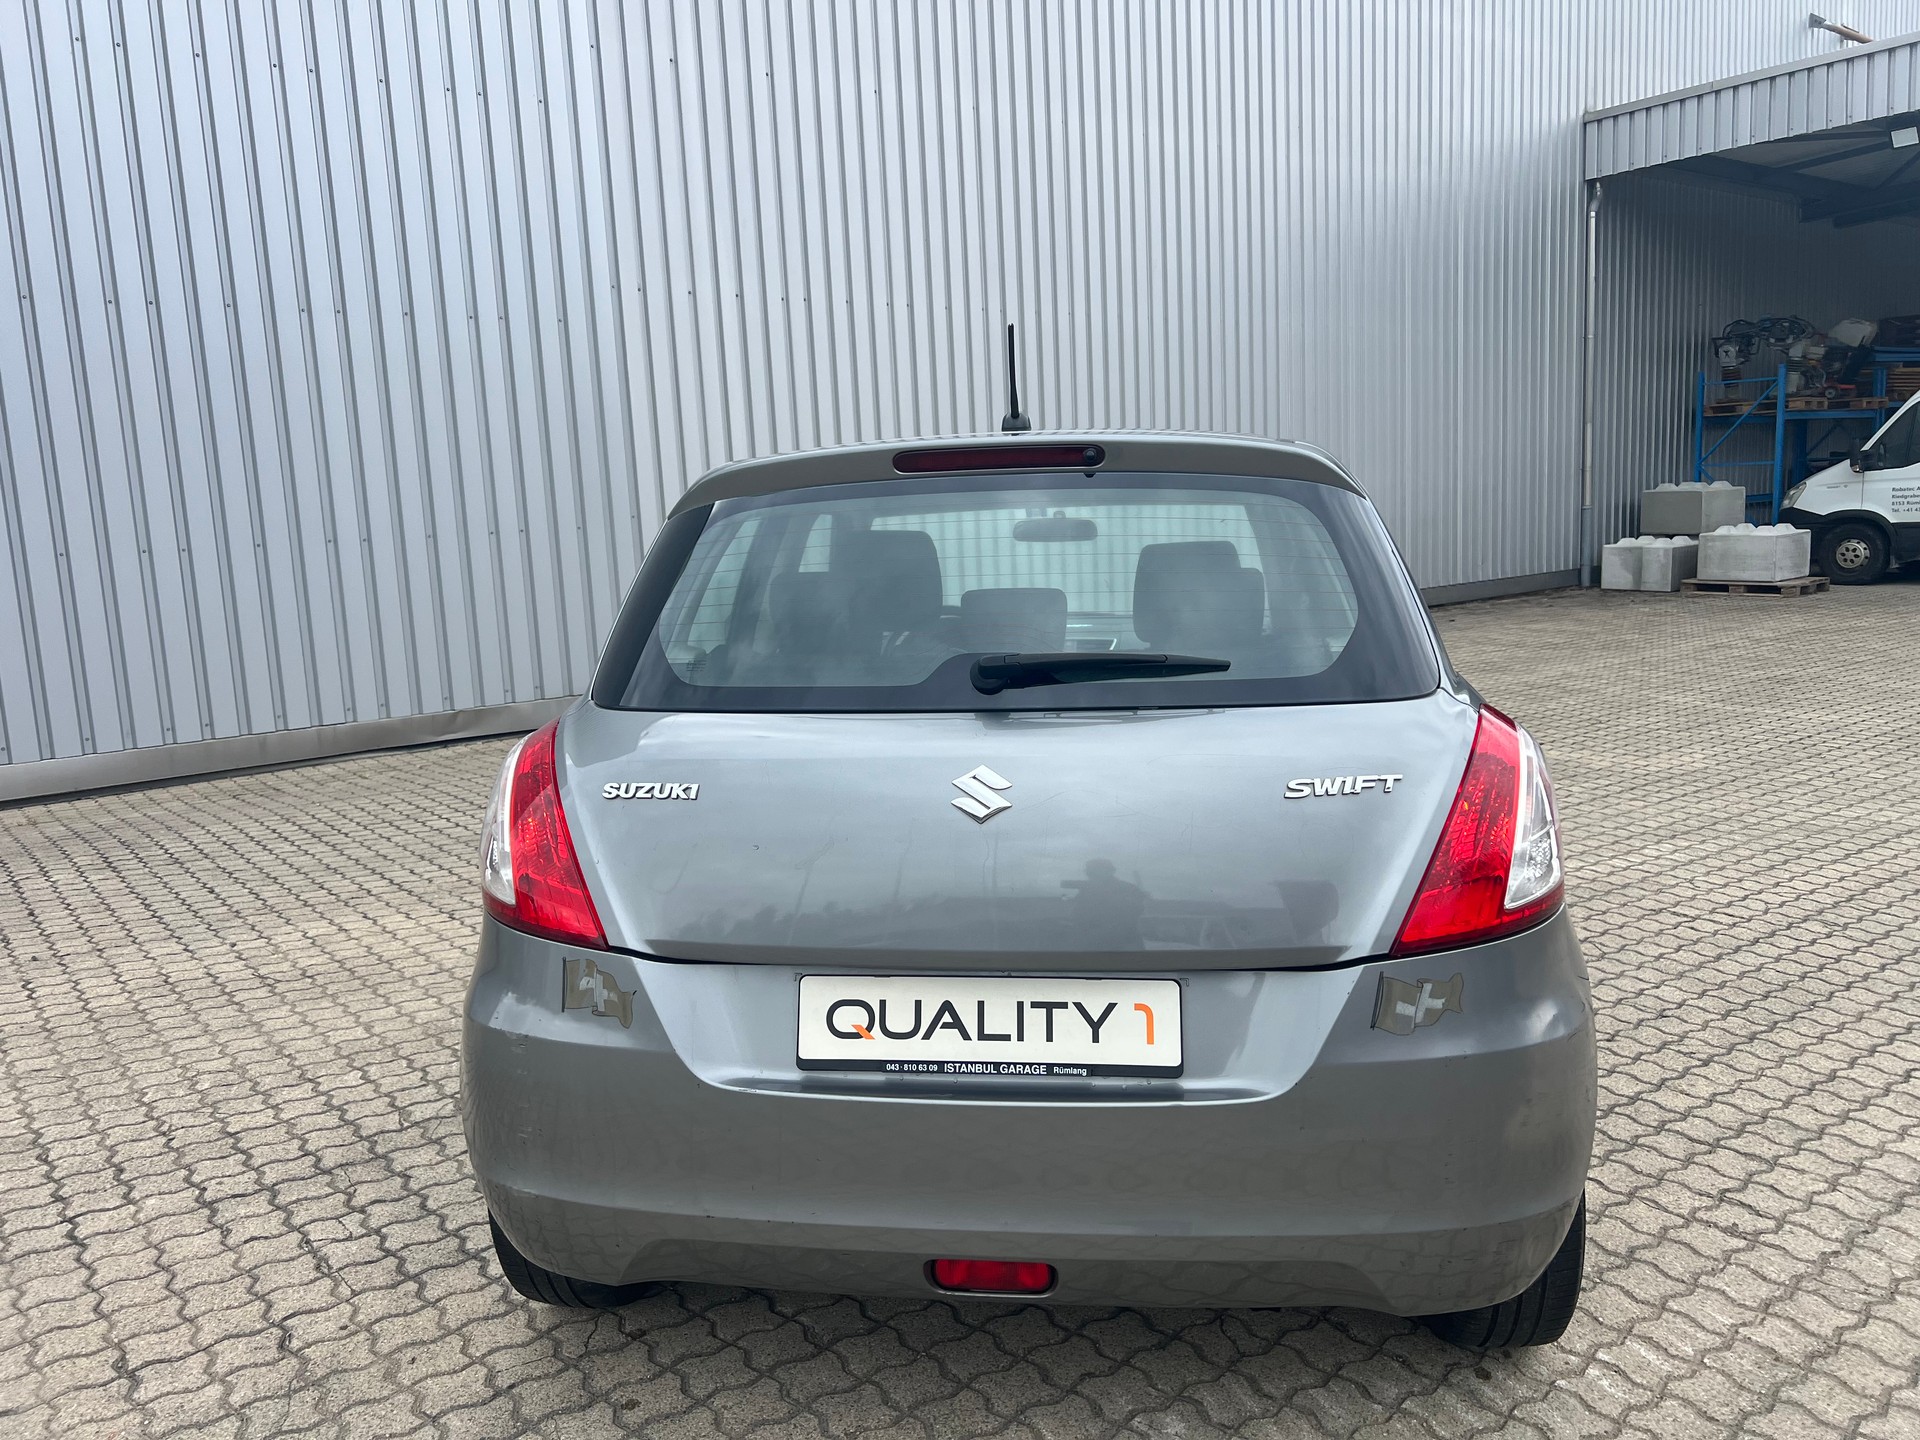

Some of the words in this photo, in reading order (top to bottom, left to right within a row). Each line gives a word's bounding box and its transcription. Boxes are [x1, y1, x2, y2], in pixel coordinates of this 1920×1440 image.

[601, 782, 700, 801] SUZUKI
[1283, 774, 1403, 799] SWIFT
[825, 999, 1118, 1043] QUALITY
[1133, 1002, 1155, 1045] 1
[918, 1064, 927, 1072] 63
[928, 1064, 938, 1072] 09
[944, 1063, 998, 1074] ISTANBUL
[999, 1064, 1047, 1075] GARAGE
[1053, 1066, 1087, 1076] Rümlang
